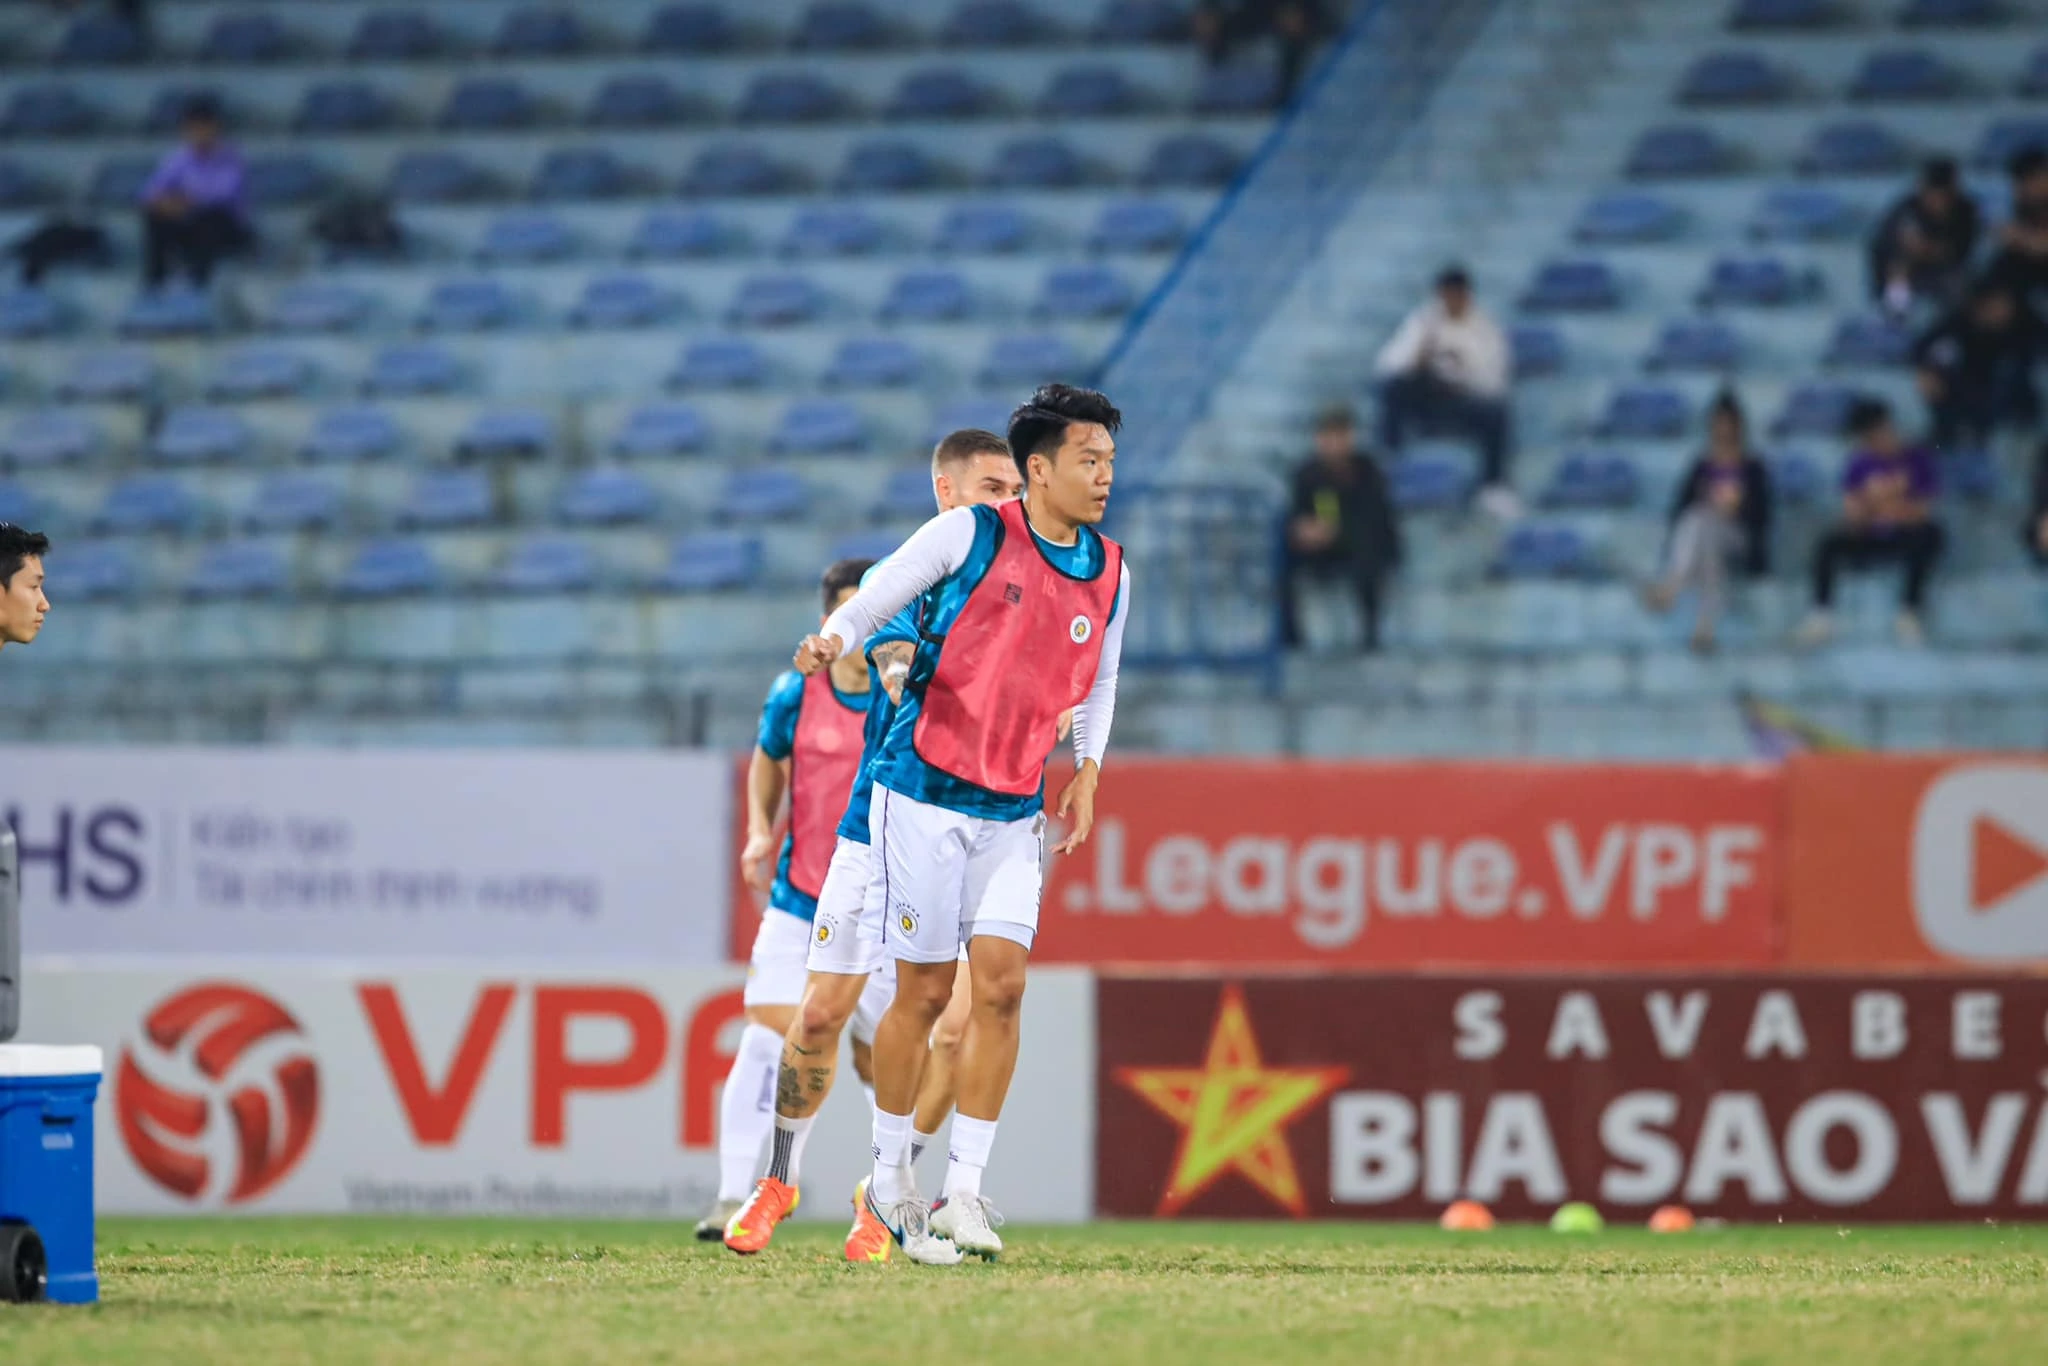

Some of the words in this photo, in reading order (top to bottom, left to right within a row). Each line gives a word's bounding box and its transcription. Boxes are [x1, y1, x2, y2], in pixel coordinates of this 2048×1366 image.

[1453, 991, 2048, 1061] SAVABE
[1329, 1092, 1567, 1204] BIA
[1600, 1090, 1898, 1205] SAO
[1920, 1070, 2048, 1205] V
